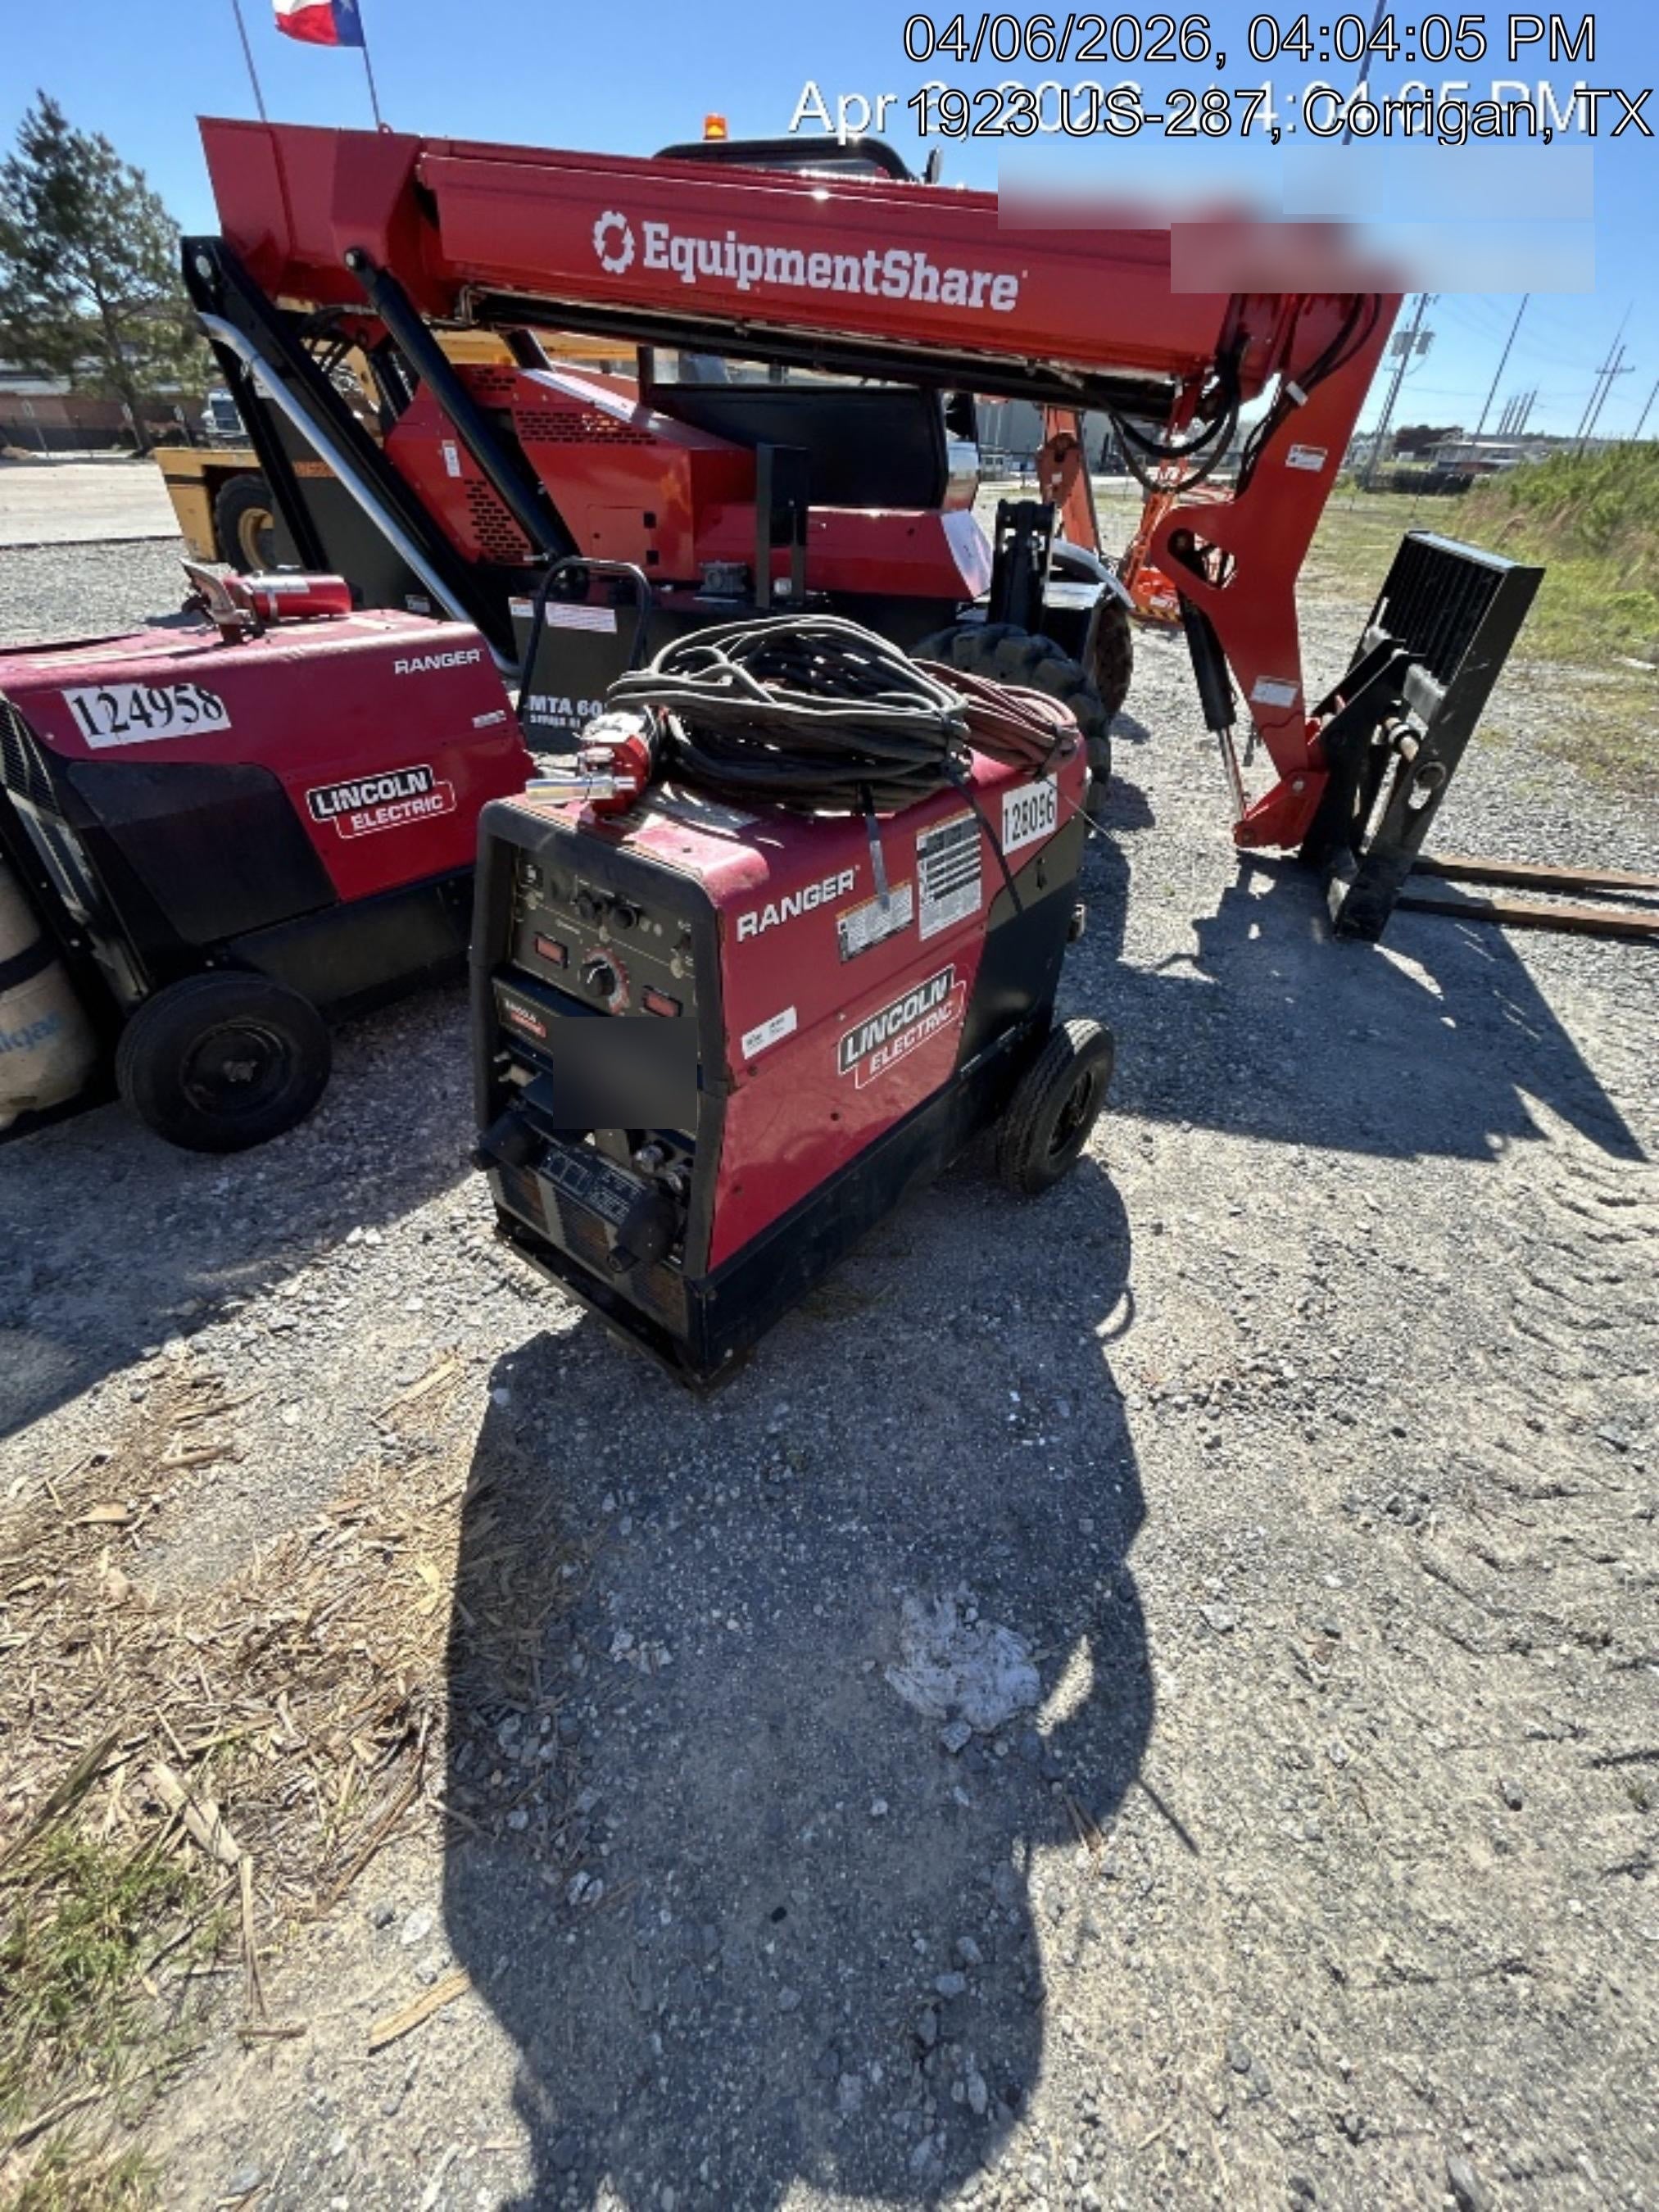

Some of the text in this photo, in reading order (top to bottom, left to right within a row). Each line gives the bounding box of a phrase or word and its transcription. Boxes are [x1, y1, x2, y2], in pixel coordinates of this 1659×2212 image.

[642, 221, 1018, 311] EquipmentShare
[395, 649, 480, 674] RANGER
[72, 685, 223, 736] 124958
[530, 695, 573, 715] MTA
[315, 771, 428, 815] LINCOLN
[351, 795, 443, 831] ELECTRIC
[737, 869, 854, 942] RANGER
[845, 975, 947, 1065] LINCOLN
[869, 1001, 952, 1075] ELECTRIC
